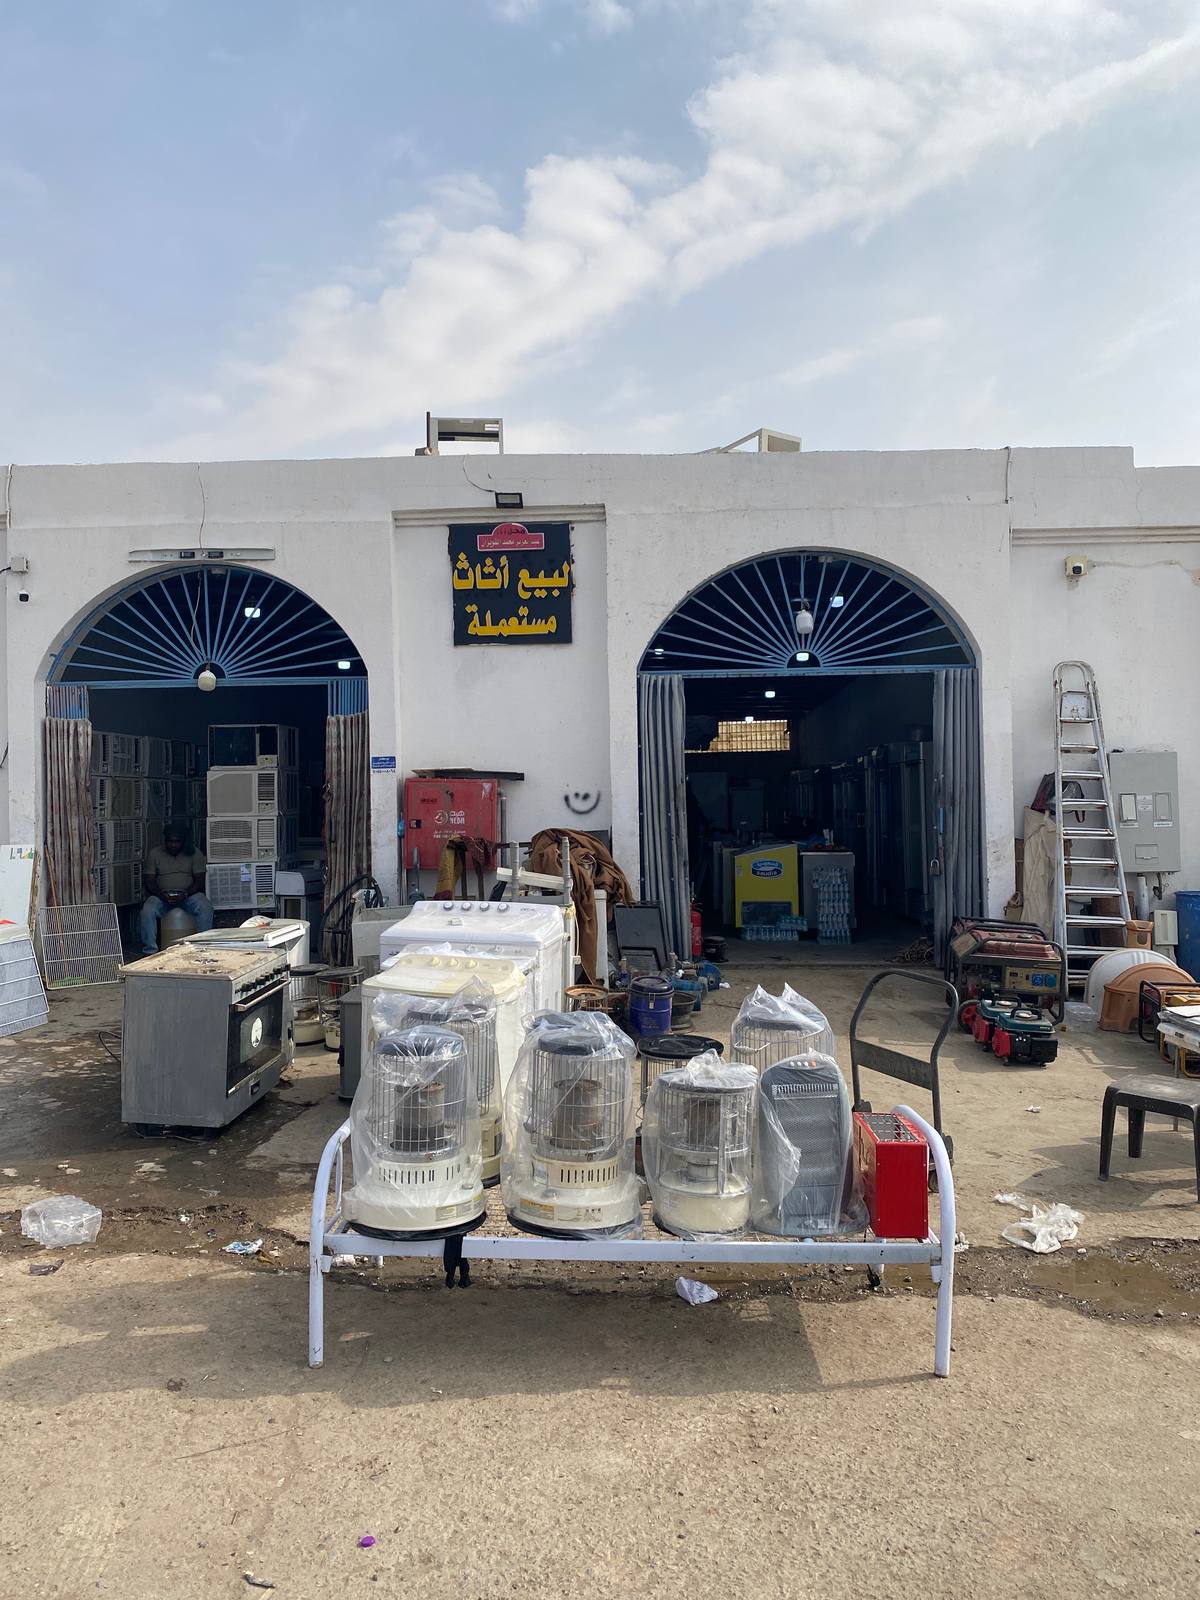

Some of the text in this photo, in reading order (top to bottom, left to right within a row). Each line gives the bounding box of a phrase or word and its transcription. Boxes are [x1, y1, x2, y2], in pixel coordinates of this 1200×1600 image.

[453, 552, 569, 600] لبيع أثاث
[465, 603, 557, 637] مستعملة
